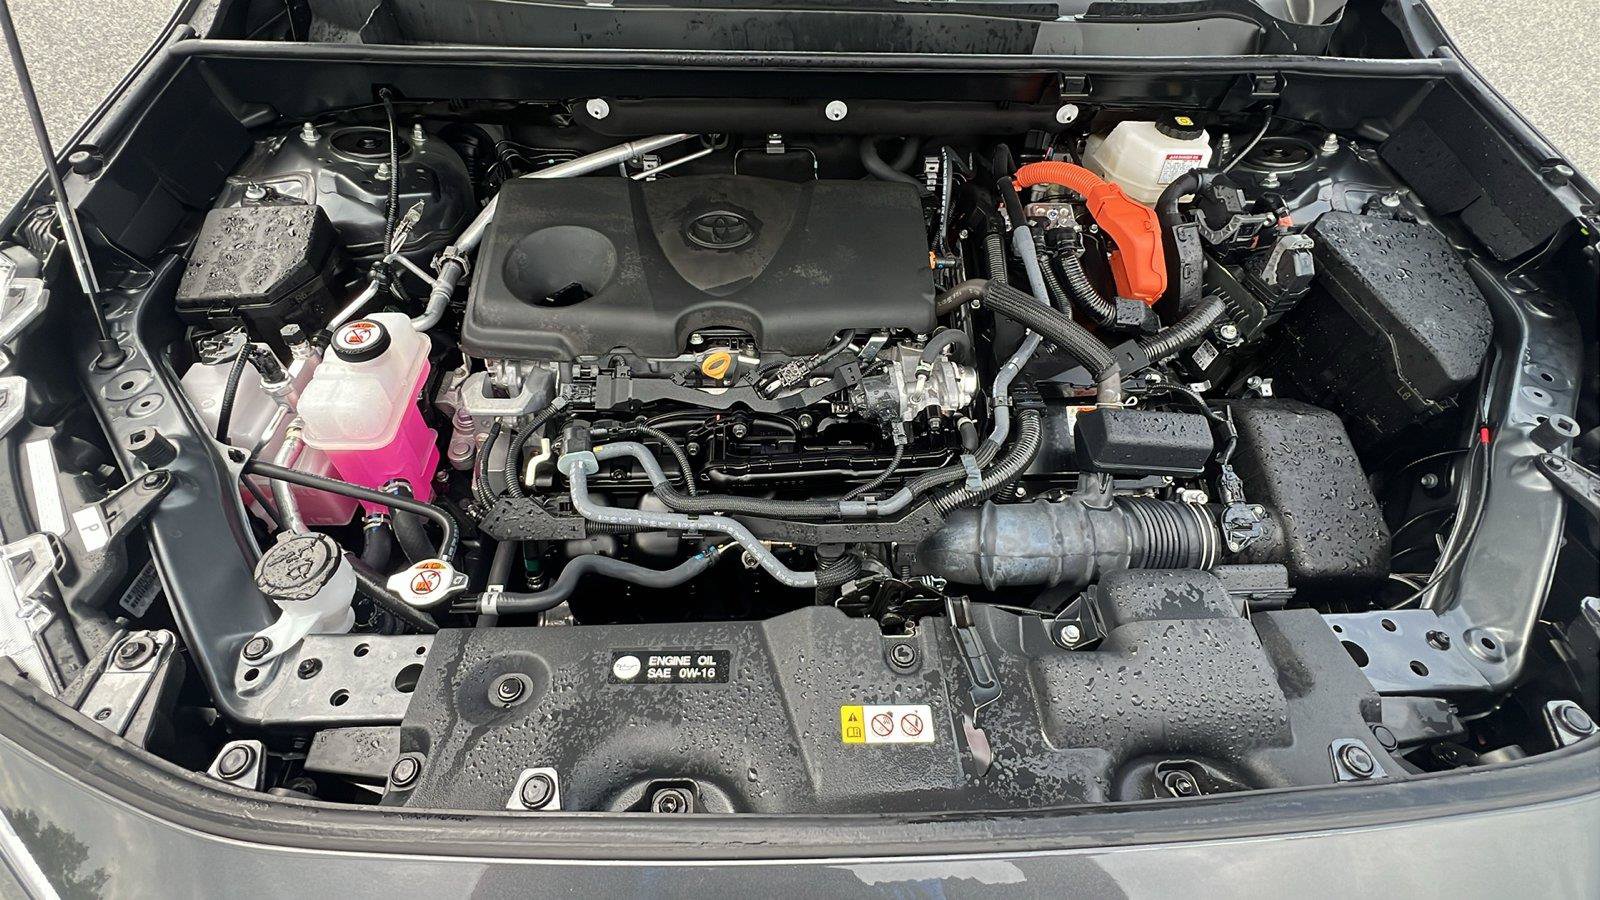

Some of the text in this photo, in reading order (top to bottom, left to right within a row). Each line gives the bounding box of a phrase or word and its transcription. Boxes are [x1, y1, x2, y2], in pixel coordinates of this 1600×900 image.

[648, 655, 716, 666] ENGINE OIL
[647, 667, 671, 678] SAE
[679, 667, 716, 678] 0W-16
